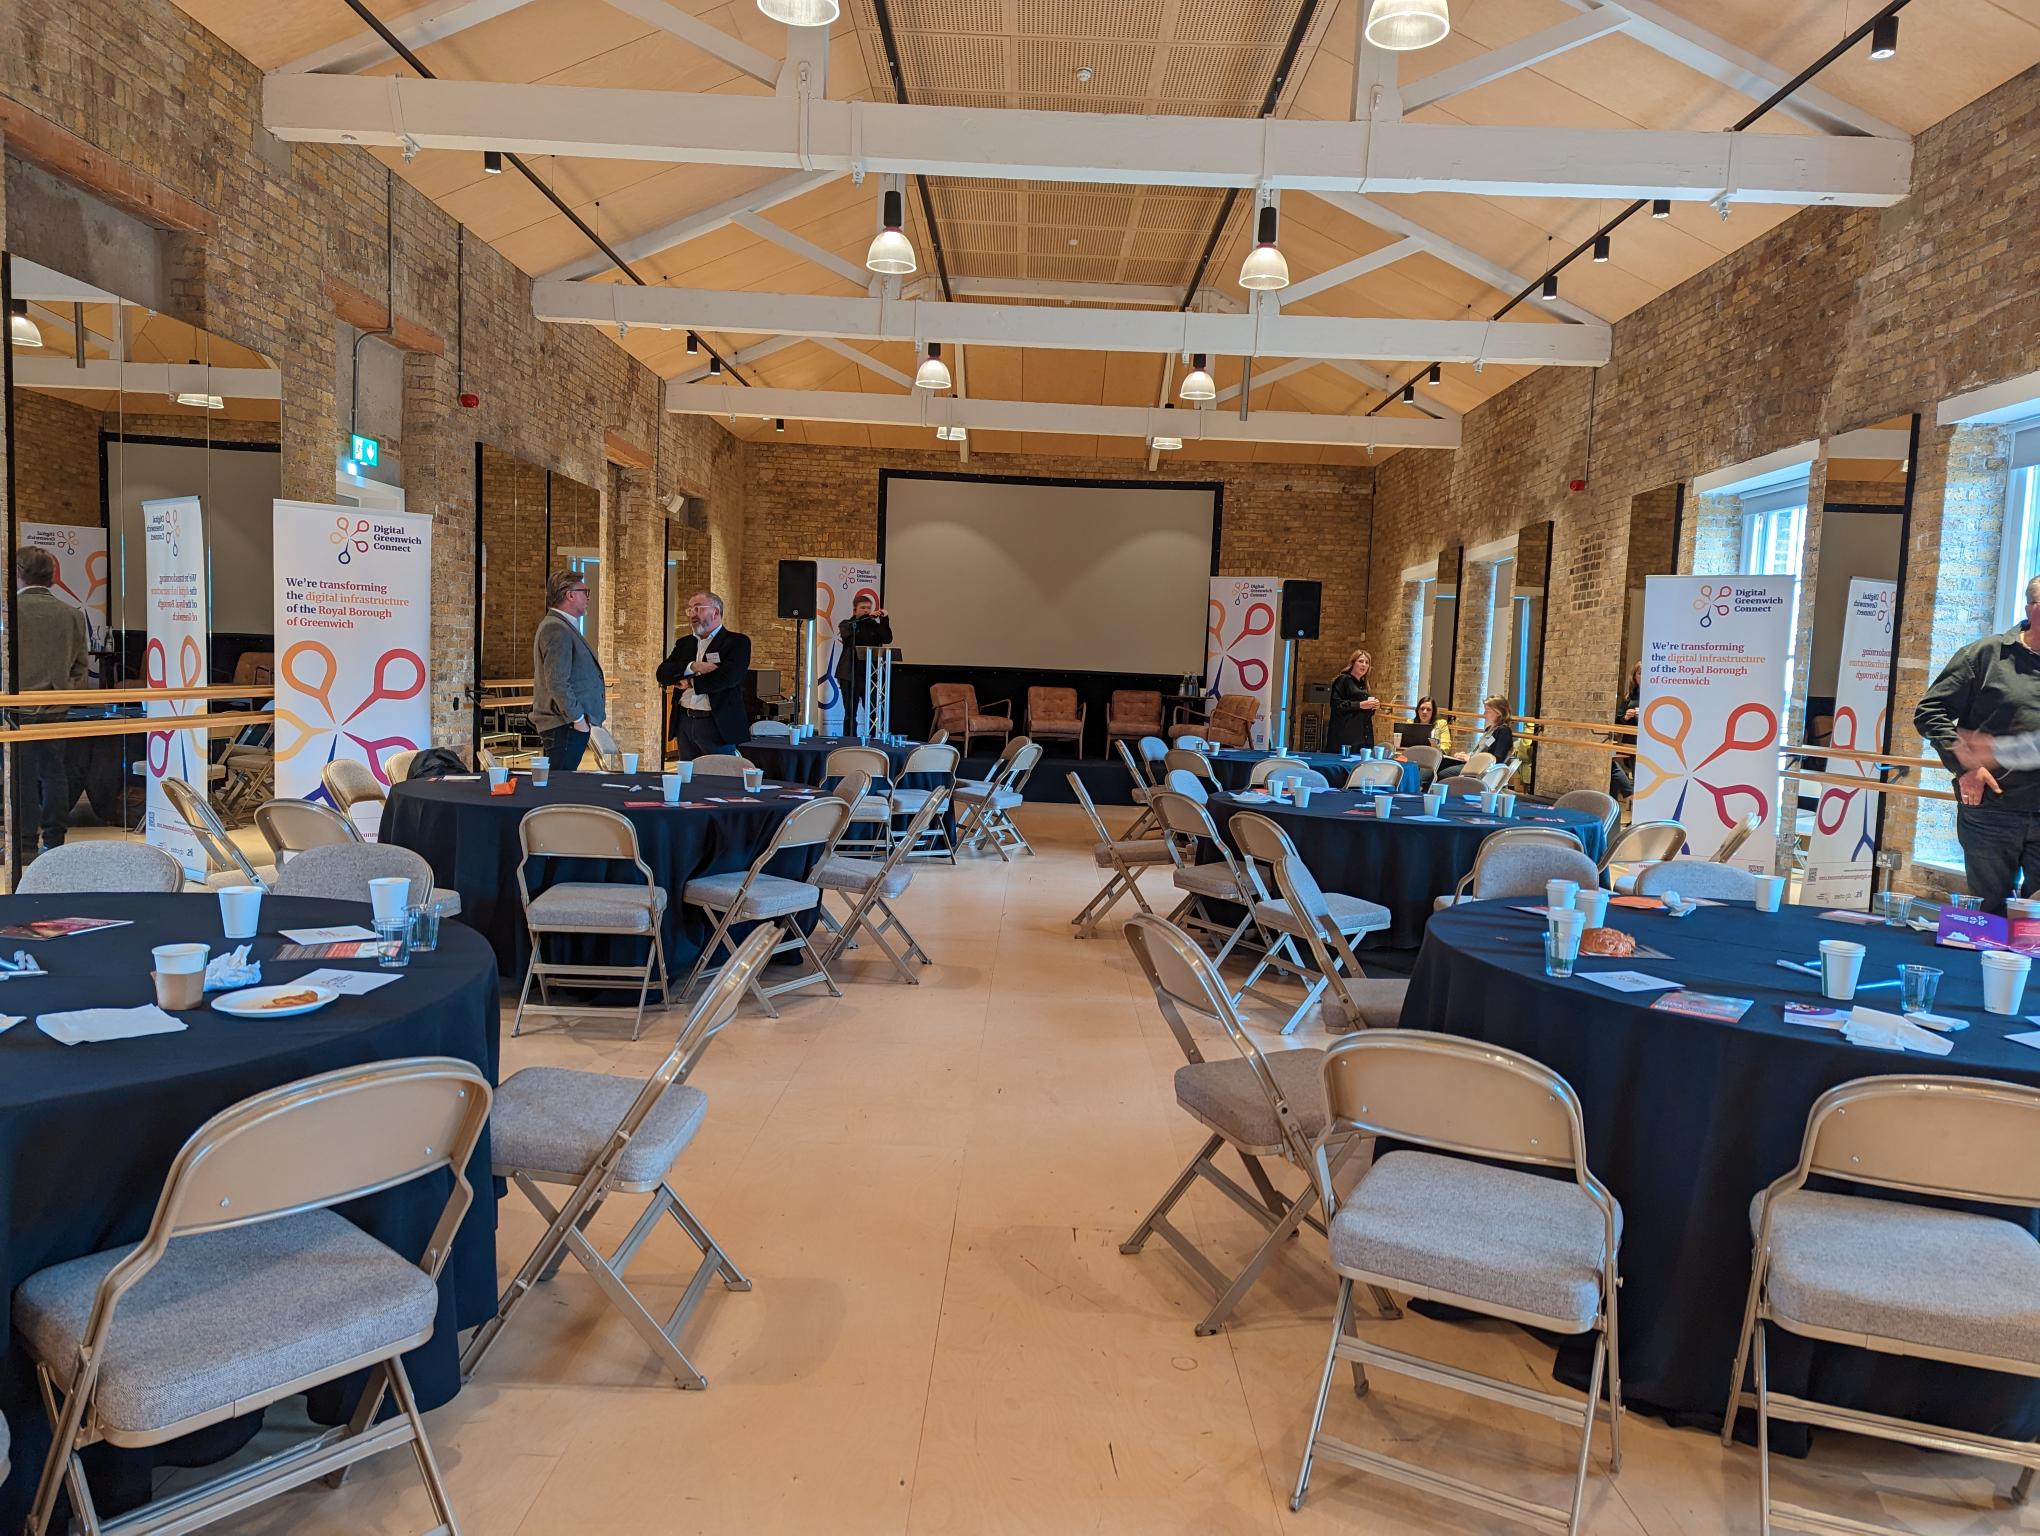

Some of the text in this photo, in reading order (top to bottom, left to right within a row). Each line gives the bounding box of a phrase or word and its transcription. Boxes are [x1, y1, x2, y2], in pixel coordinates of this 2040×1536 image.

[373, 525, 404, 535] Digital
[373, 534, 422, 545] Greenwich
[373, 543, 411, 552] Connect
[286, 577, 387, 594] We're transforming
[1735, 588, 1766, 597] Digital
[287, 591, 409, 607] the digital infrastructure
[1734, 597, 1783, 605] Greenwich
[287, 604, 392, 620] of the Royal Borough
[287, 617, 354, 629] of Greenwich
[1652, 641, 1745, 653] We're transforming
[1651, 653, 1766, 664] the digital infrastructure
[1650, 665, 1748, 677] of the Royal Borough
[1650, 676, 1710, 686] of Greenwich
